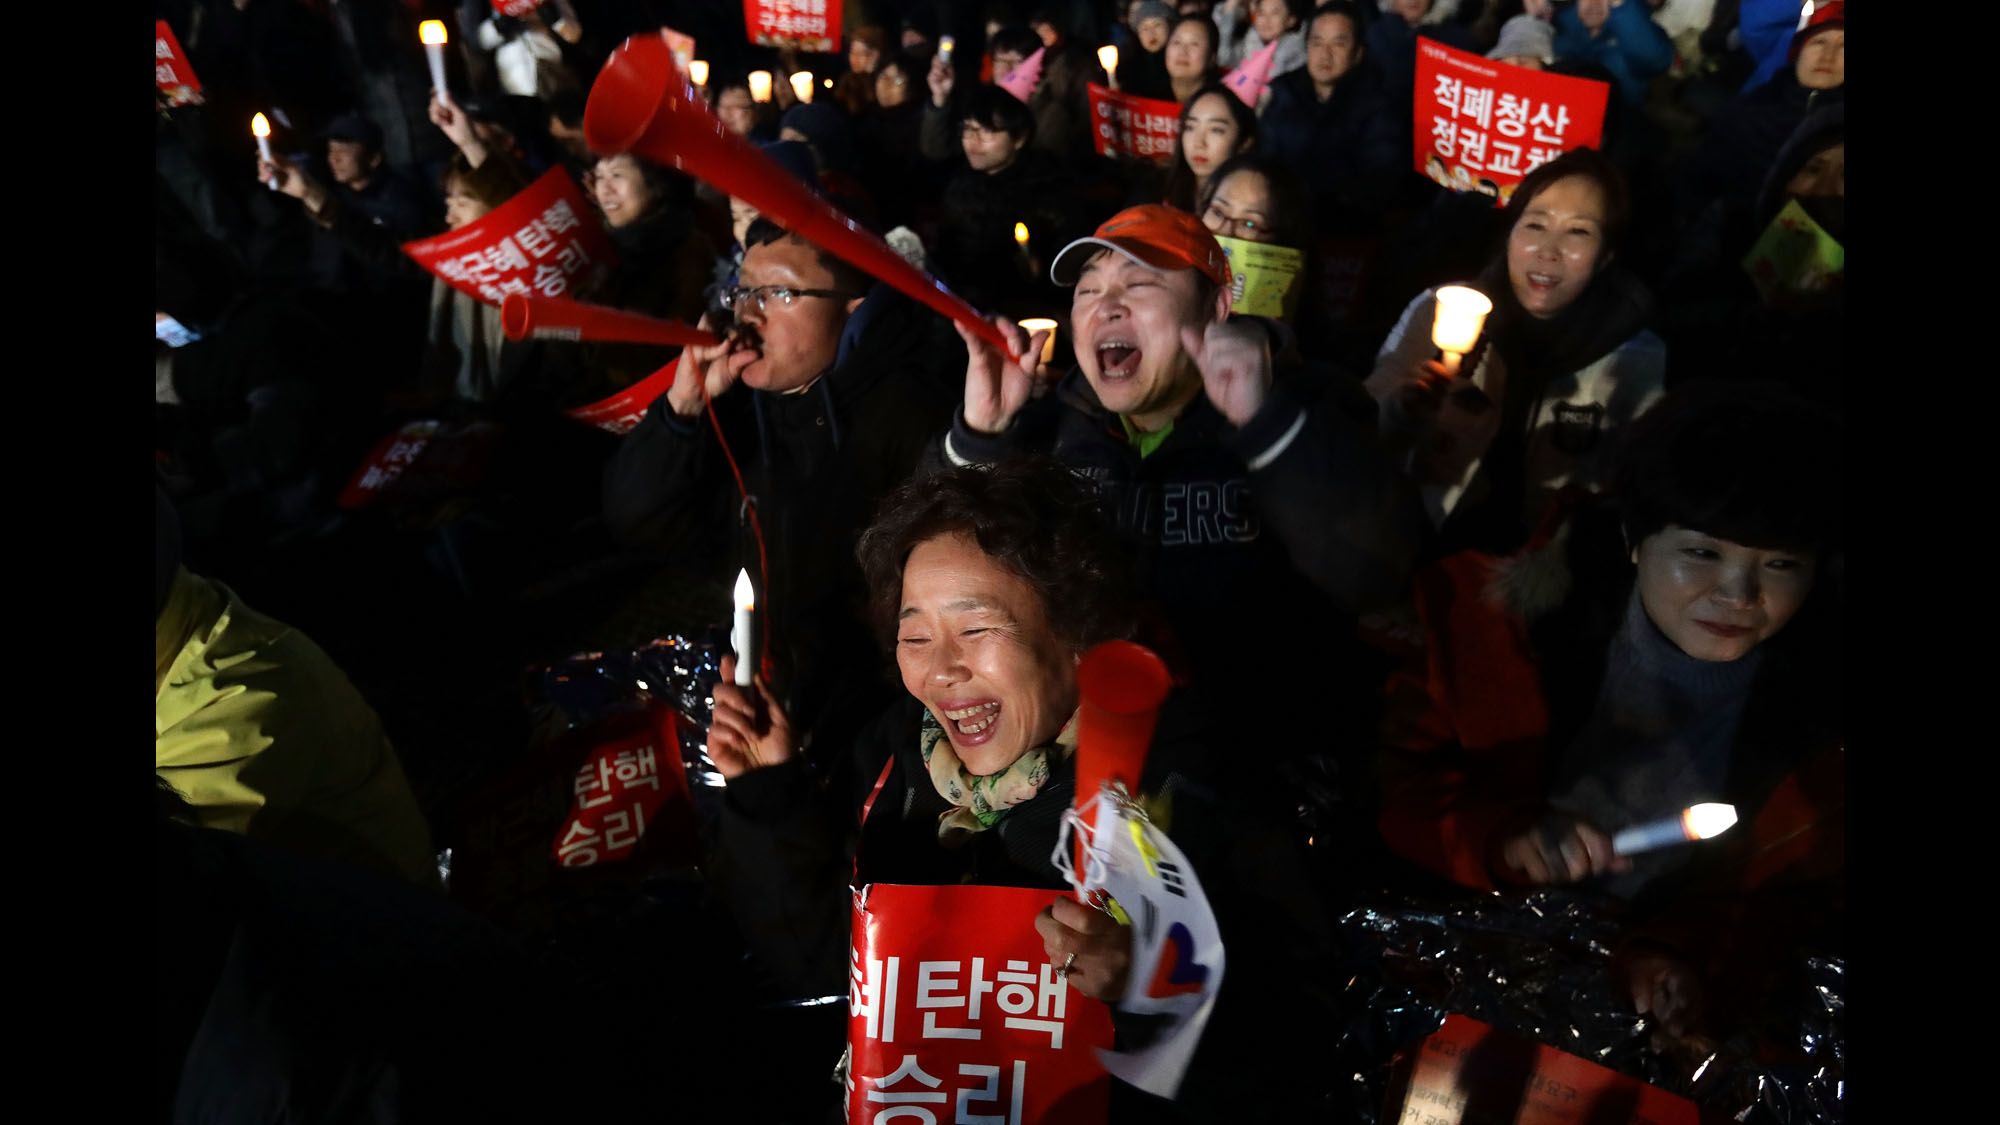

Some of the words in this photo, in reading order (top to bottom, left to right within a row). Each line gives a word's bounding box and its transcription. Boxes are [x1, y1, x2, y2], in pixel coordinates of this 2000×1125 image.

[1433, 73, 1570, 145] 적폐청산
[533, 239, 590, 297] 승리
[574, 745, 660, 810] 탄핵
[558, 801, 646, 868] 승리
[916, 957, 1067, 1049] 탄핵
[867, 1055, 1027, 1125] 승리
